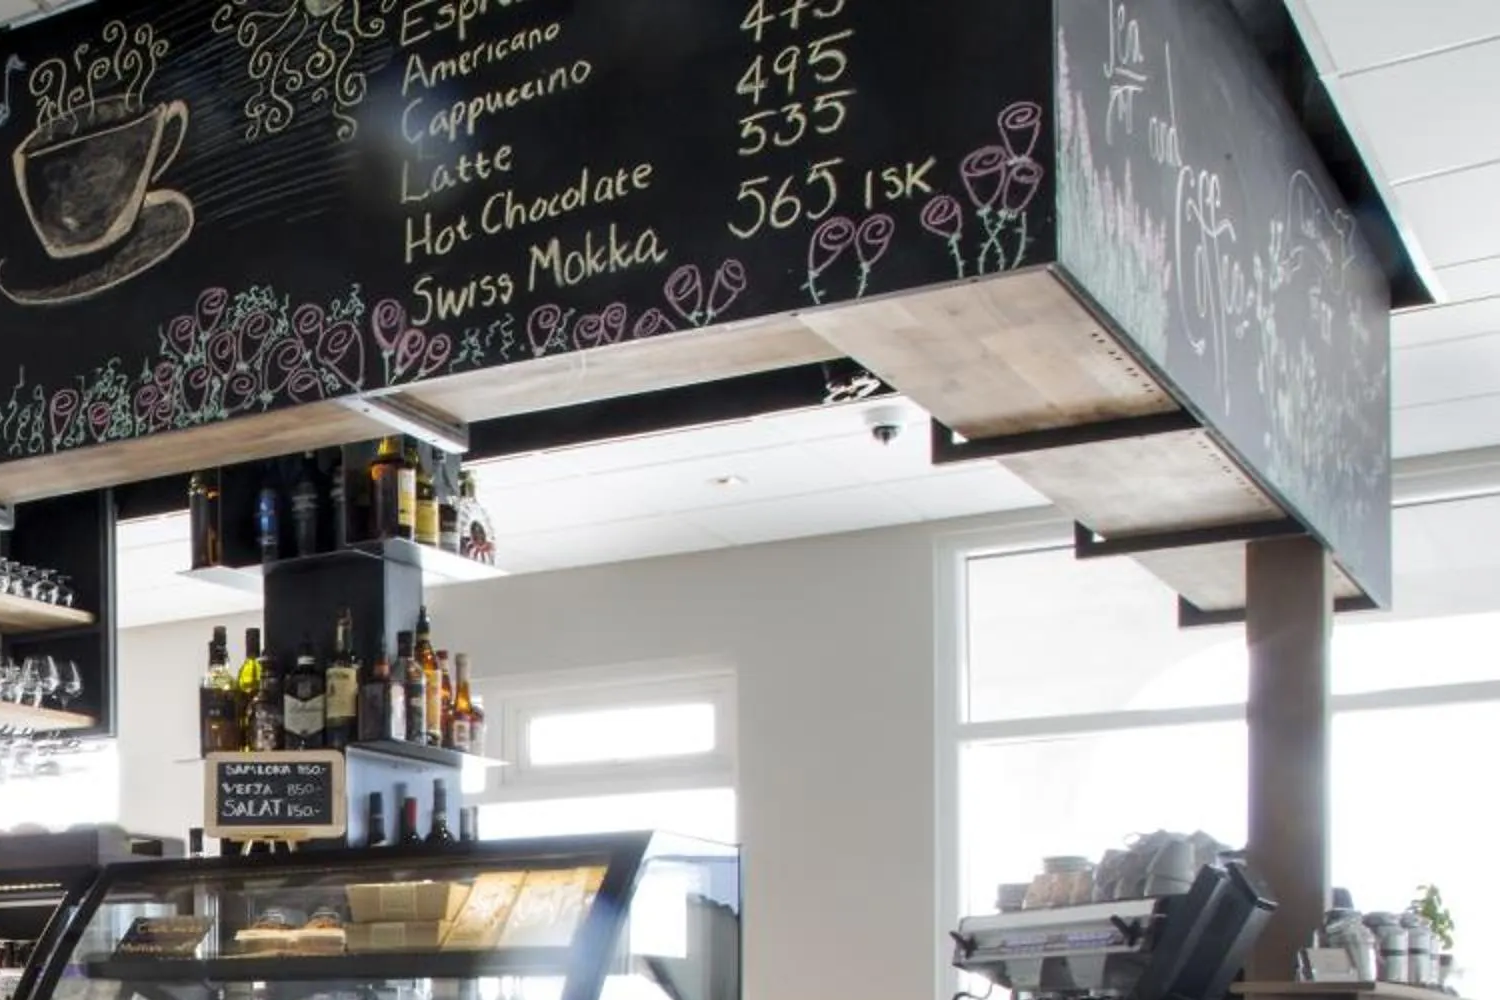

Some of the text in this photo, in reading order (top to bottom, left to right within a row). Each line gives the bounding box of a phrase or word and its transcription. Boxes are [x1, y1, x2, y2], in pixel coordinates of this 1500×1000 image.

[402, 22, 561, 97] Americano
[736, 29, 855, 104] 495
[401, 60, 592, 147] Cappuccino
[738, 89, 857, 156] 535
[401, 144, 513, 203] Latte
[727, 156, 937, 239] 565 ISK
[404, 161, 654, 264] Hot Chocolate
[411, 222, 668, 327] Swiss Mokka
[222, 800, 282, 817] SALAT
